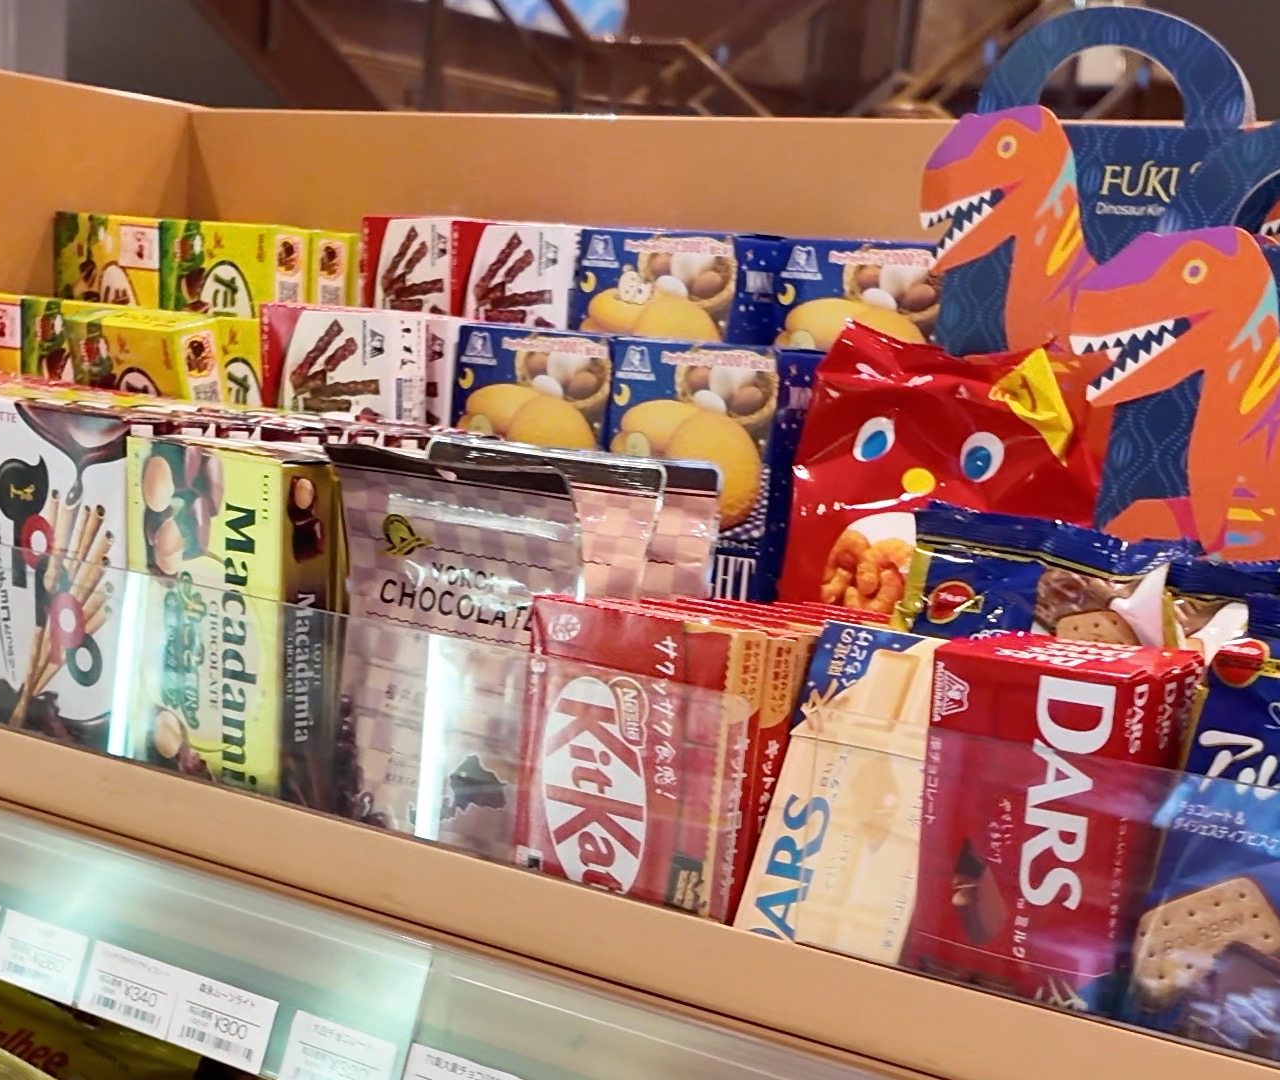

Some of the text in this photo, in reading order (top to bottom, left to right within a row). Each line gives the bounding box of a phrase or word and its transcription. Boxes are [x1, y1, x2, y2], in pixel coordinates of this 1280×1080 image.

[221, 501, 258, 787] Macadami
[380, 578, 533, 632] CHOCOLATE
[293, 592, 316, 744] Macadamia
[1128, 683, 1150, 755] DARS
[545, 697, 645, 894] KitKat
[1021, 675, 1117, 911] DARS
[121, 982, 158, 1009] ¥340
[212, 1013, 248, 1041] ¥300
